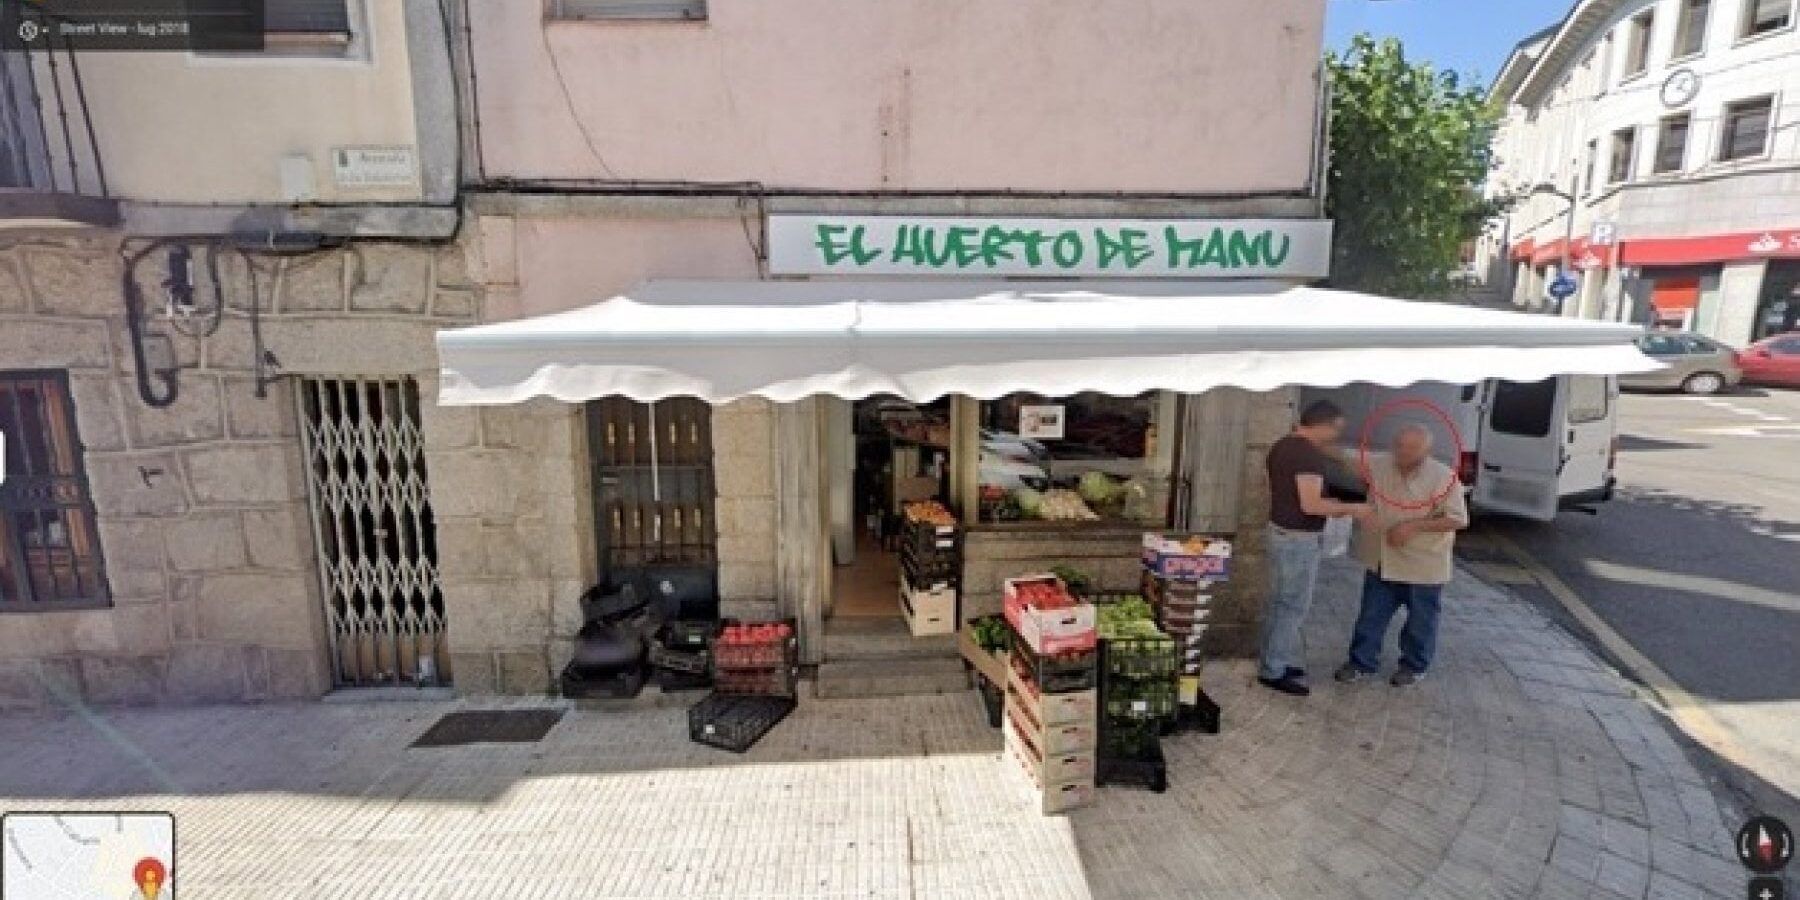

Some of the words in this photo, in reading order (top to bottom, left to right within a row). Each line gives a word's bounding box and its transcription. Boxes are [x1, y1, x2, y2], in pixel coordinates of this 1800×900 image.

[815, 225, 881, 266] EL
[892, 225, 1084, 268] HUERTO
[1094, 228, 1154, 268] DE
[1165, 225, 1289, 268] MANU
